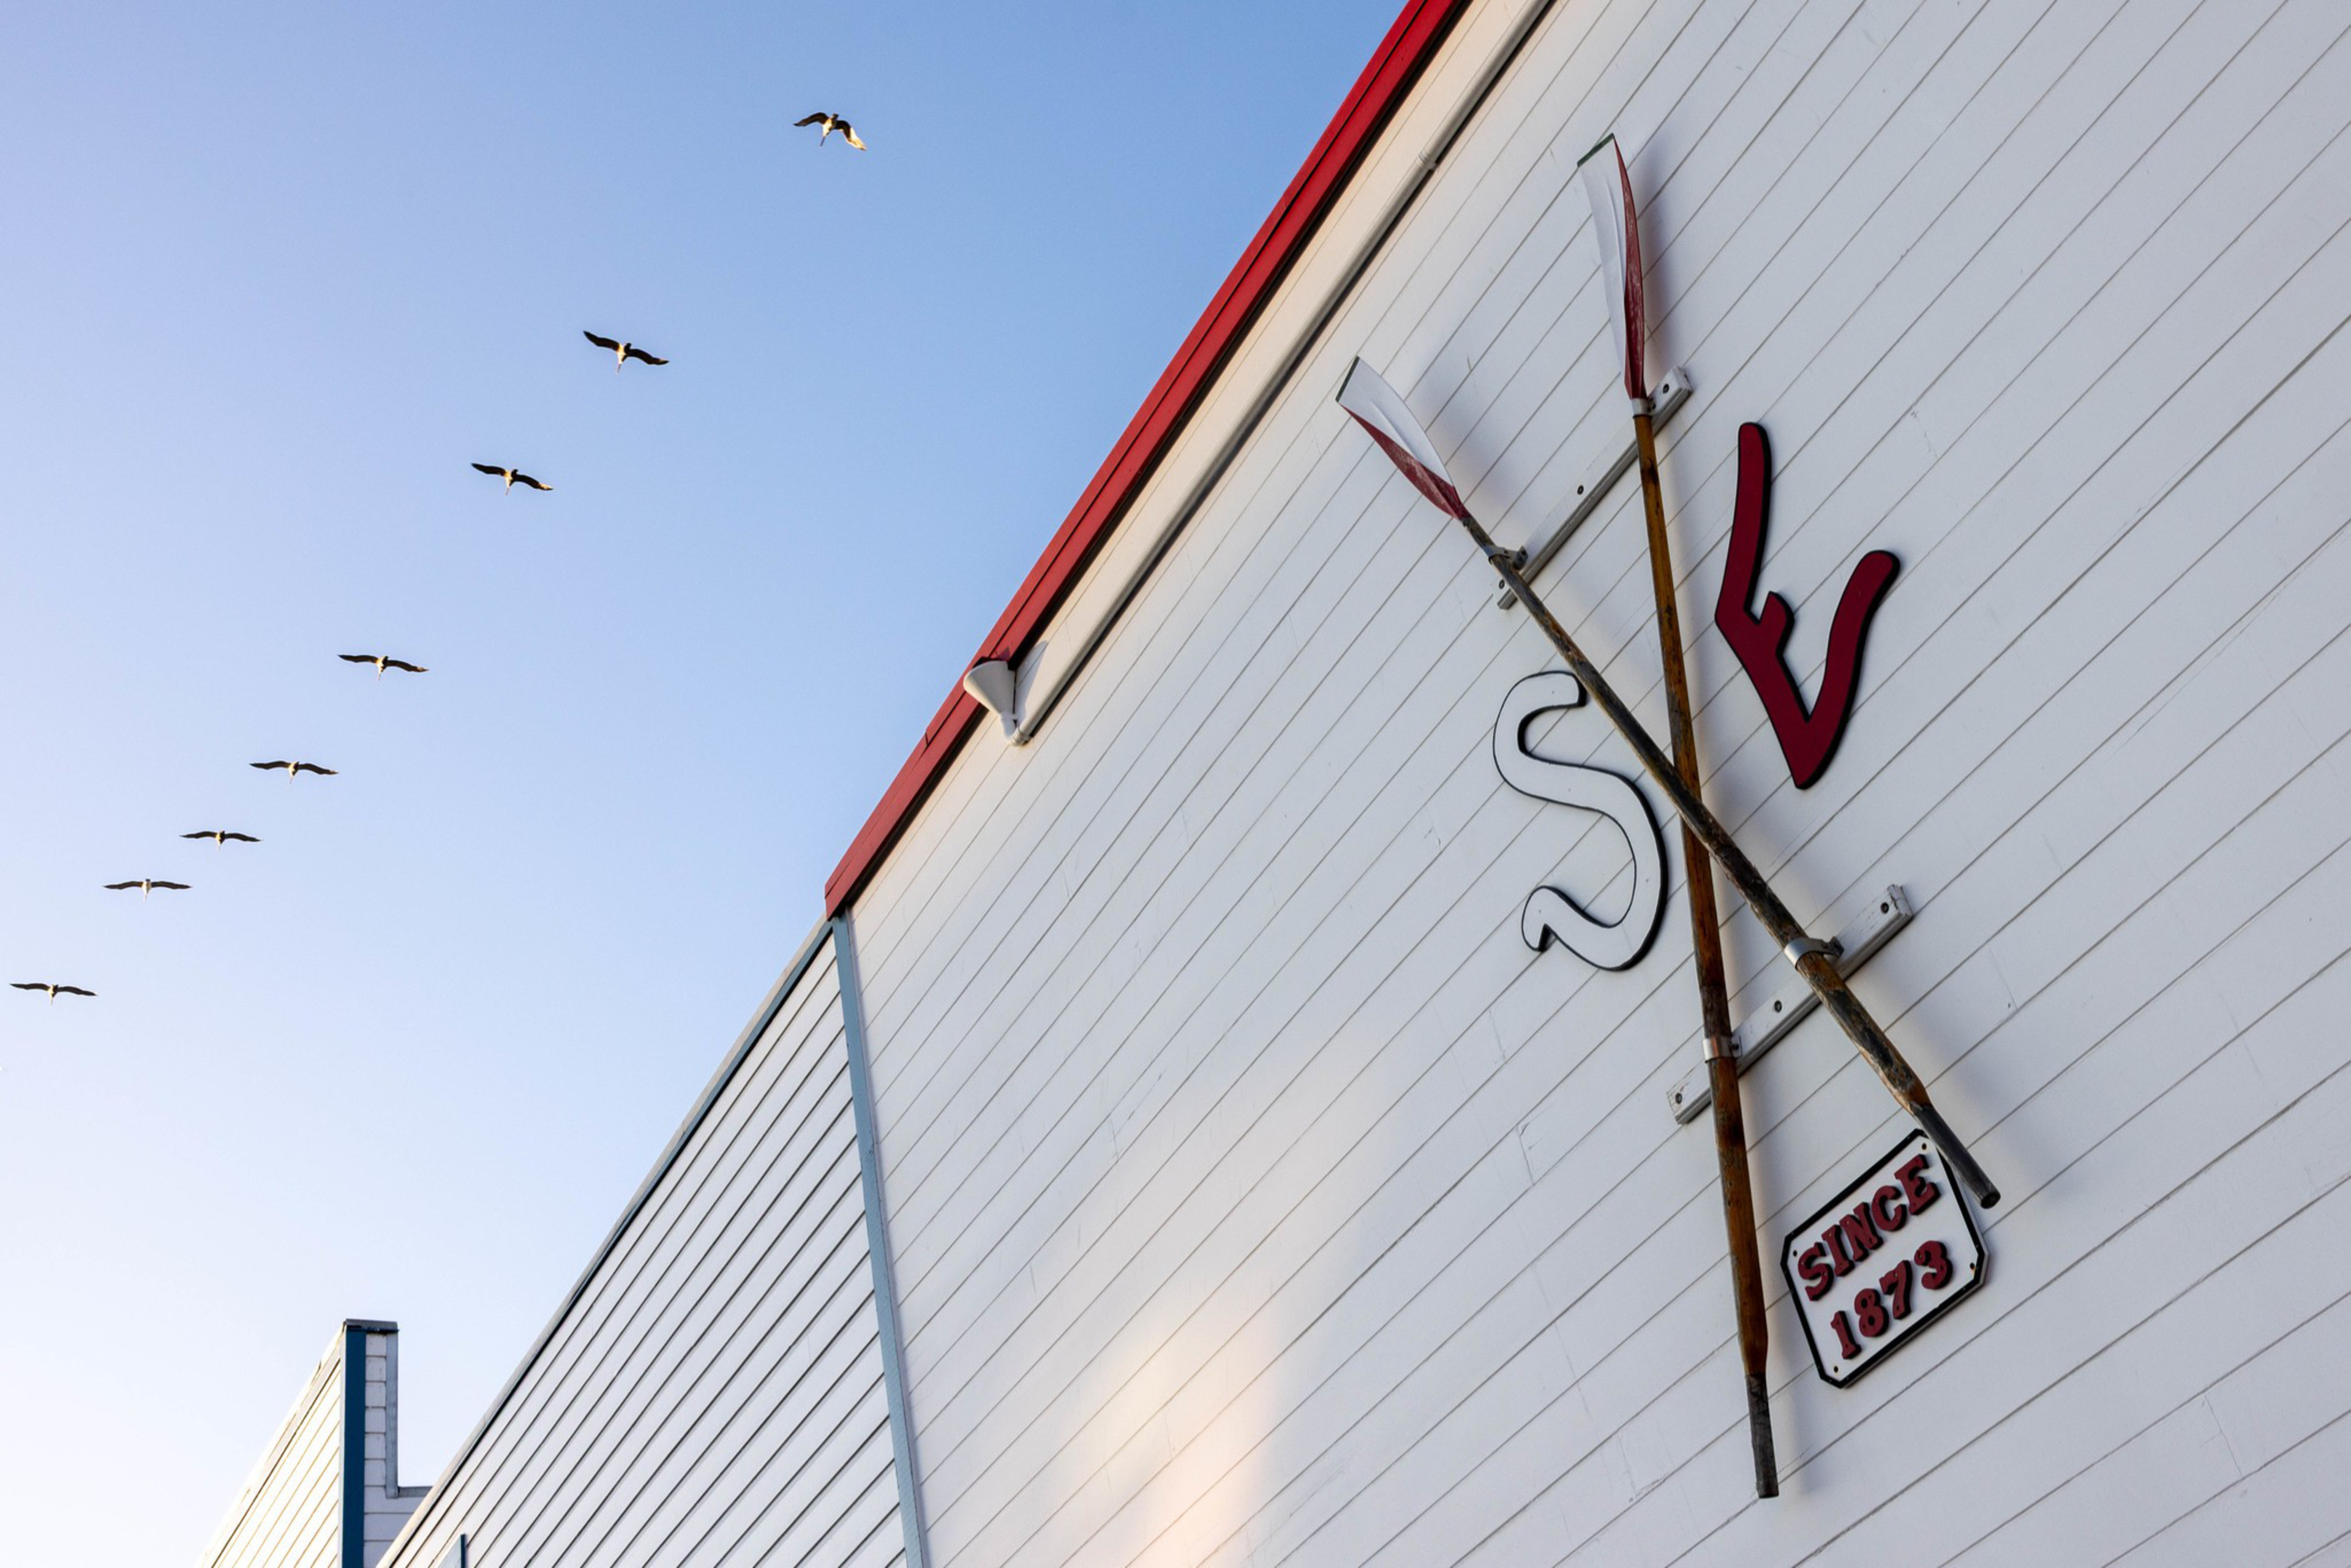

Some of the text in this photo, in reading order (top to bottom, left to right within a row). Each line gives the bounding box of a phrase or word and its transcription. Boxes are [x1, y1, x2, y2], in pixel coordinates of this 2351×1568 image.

[1493, 670, 1669, 972] S
[1798, 1153, 1941, 1301] SINCE
[1830, 1240, 1953, 1360] 1873
